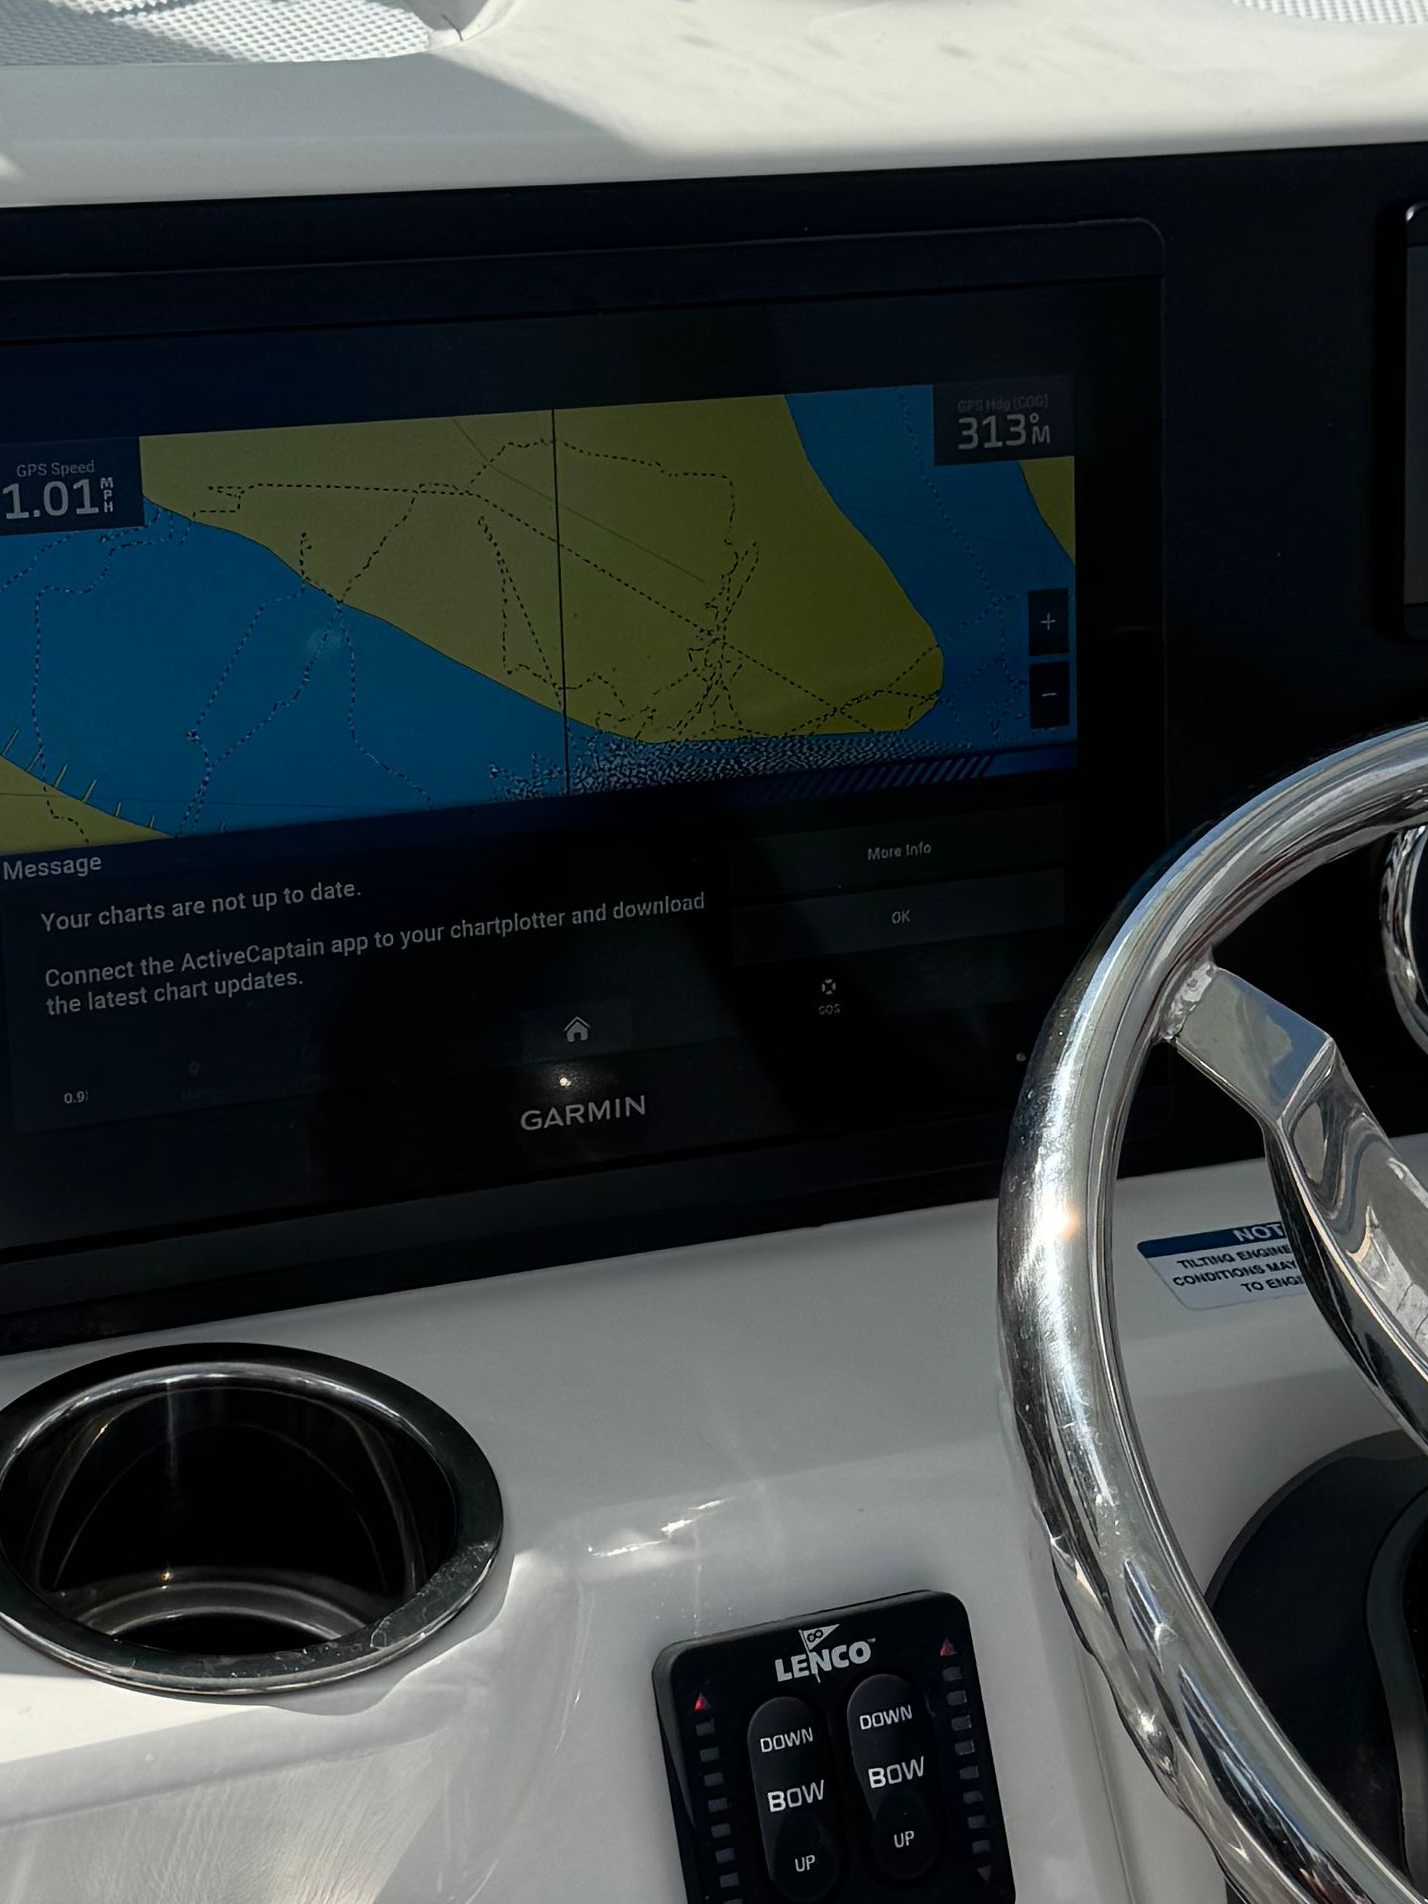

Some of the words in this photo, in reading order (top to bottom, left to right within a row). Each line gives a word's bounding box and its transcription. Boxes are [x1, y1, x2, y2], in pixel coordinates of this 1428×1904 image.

[16, 463, 48, 477] GPS
[51, 459, 96, 476] Speed
[2, 478, 100, 520] 1.01
[866, 846, 902, 862] More
[905, 840, 932, 857] Info
[2, 854, 104, 881] Message
[40, 909, 93, 934] Your
[98, 903, 166, 928] charts
[172, 899, 206, 919] are
[211, 892, 247, 913] not
[252, 891, 278, 911] up
[283, 887, 304, 905] to
[309, 880, 362, 902] date.
[891, 909, 912, 925] OK
[44, 961, 134, 988] Connect
[139, 955, 174, 976] the
[180, 937, 325, 973] ActiveCaptain
[330, 934, 369, 958] app
[373, 930, 395, 948] to
[398, 925, 445, 950] your
[449, 909, 567, 939] chartplotter
[571, 903, 607, 925] and
[612, 892, 706, 920] download
[45, 996, 81, 1016] the
[87, 986, 148, 1012] latest
[153, 979, 209, 1004] chart
[213, 970, 304, 999] updates.
[519, 1094, 647, 1132] GARMIN
[1232, 1222, 1285, 1243] NOT
[1172, 1264, 1266, 1287] CONDITIONS
[1266, 1259, 1298, 1274] MAY
[1176, 1252, 1236, 1270] TILTING
[1240, 1280, 1264, 1293] TO
[1265, 1275, 1306, 1290] ENGI
[775, 1639, 873, 1683] LENCO
[859, 1704, 914, 1731] DOWN
[759, 1726, 815, 1753] DOWN
[868, 1756, 925, 1789] BOW
[767, 1779, 825, 1812] BOW
[893, 1830, 915, 1848] UP
[794, 1854, 816, 1873] UP
